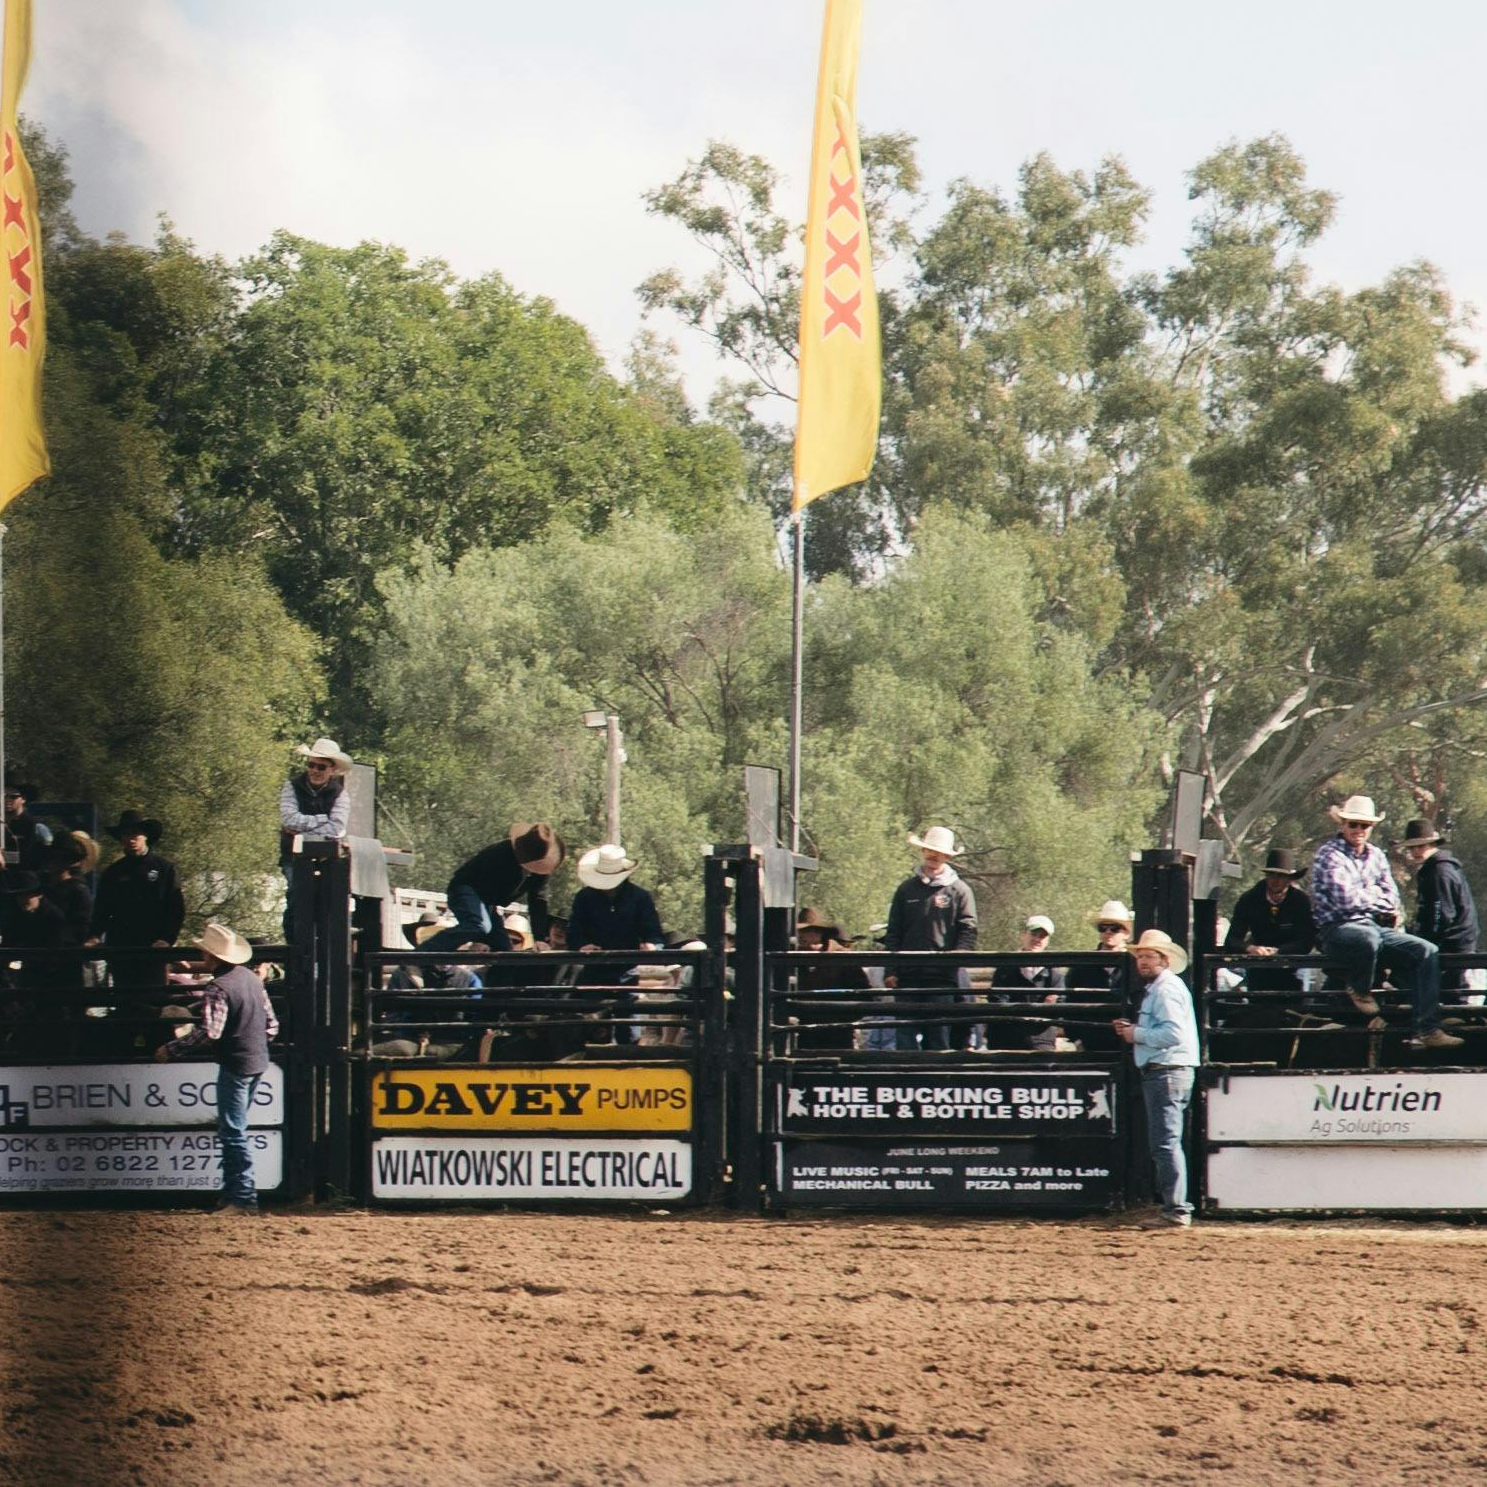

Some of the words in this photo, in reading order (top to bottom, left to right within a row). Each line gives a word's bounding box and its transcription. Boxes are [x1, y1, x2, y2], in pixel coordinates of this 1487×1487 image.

[32, 1083, 132, 1110] BRIEN
[144, 1083, 168, 1108] &
[178, 1081, 274, 1107] SOS
[378, 1082, 592, 1116] DAVEY
[598, 1087, 687, 1110] PUMPS
[813, 1086, 869, 1104] THE
[876, 1086, 1004, 1105] BUCKING
[1011, 1087, 1084, 1105] BULL
[1313, 1082, 1443, 1112] Nutrien
[10, 1107, 25, 1124] F
[813, 1104, 889, 1118] HOTEL
[896, 1104, 914, 1119] &
[921, 1105, 1013, 1119] BOTTLE
[1018, 1105, 1085, 1120] SHOP
[1310, 1118, 1332, 1137] Ag
[1336, 1118, 1411, 1135] Solutions
[46, 1136, 59, 1153] &
[65, 1135, 175, 1153] PROPERTY
[886, 1147, 916, 1157] JUNE
[916, 1147, 947, 1156] LONG
[948, 1146, 1000, 1156] WEEKEND
[7, 1157, 46, 1173] Ph:
[56, 1156, 86, 1172] 02
[95, 1156, 159, 1172] 6822
[377, 1149, 533, 1187] WIATKOWSKI
[541, 1150, 683, 1188] ELECTRICAL
[792, 1166, 828, 1177] LIVE
[830, 1166, 880, 1177] MUSIC
[965, 1166, 1018, 1177] MEALS
[1020, 1166, 1054, 1177] 7AM
[1056, 1167, 1073, 1177] to
[1075, 1167, 1110, 1177] Late
[90, 1178, 118, 1191] grow
[122, 1178, 153, 1188] more
[157, 1175, 184, 1187] than
[186, 1175, 210, 1188] just
[792, 1179, 892, 1191] MECHANICAL
[894, 1179, 935, 1191] BULL
[965, 1179, 1011, 1190] PIZZA
[1013, 1179, 1042, 1191] and
[1045, 1181, 1084, 1191] more
